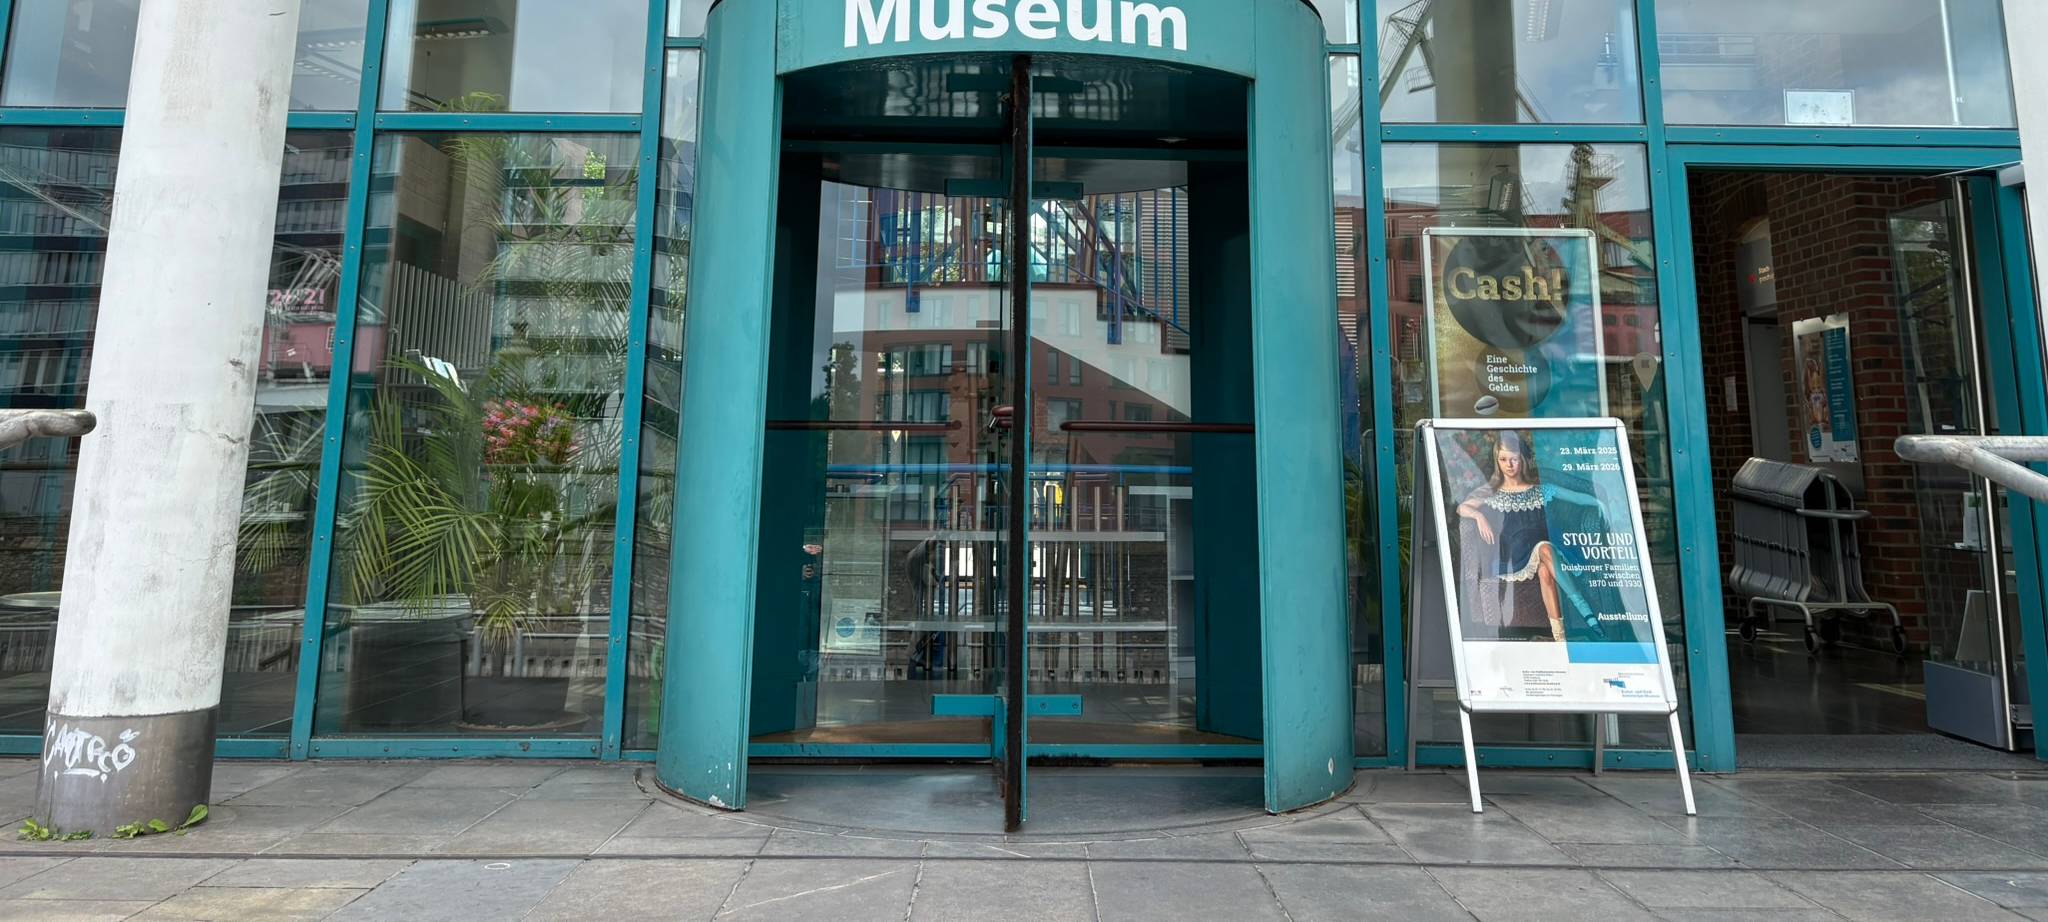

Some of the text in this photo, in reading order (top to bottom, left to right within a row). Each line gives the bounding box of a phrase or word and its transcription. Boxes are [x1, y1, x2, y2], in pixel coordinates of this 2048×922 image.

[844, 0, 1188, 51] Museum
[1450, 265, 1563, 302] Cash!
[1486, 355, 1508, 364] Eine
[1486, 365, 1538, 374] Geschichte
[1488, 374, 1504, 383] des
[1488, 383, 1520, 392] Geldes
[1560, 446, 1618, 455] 23. März 2025
[1562, 463, 1620, 471] 29. März 2026
[1562, 532, 1634, 546] STOLZ UND
[1581, 546, 1638, 560] VORTEIL
[1561, 563, 1640, 573] Duisburger Familien
[1603, 572, 1640, 580] zwischen
[1589, 580, 1642, 588] 1870 und 1930
[1597, 612, 1649, 623] Ausstellung
